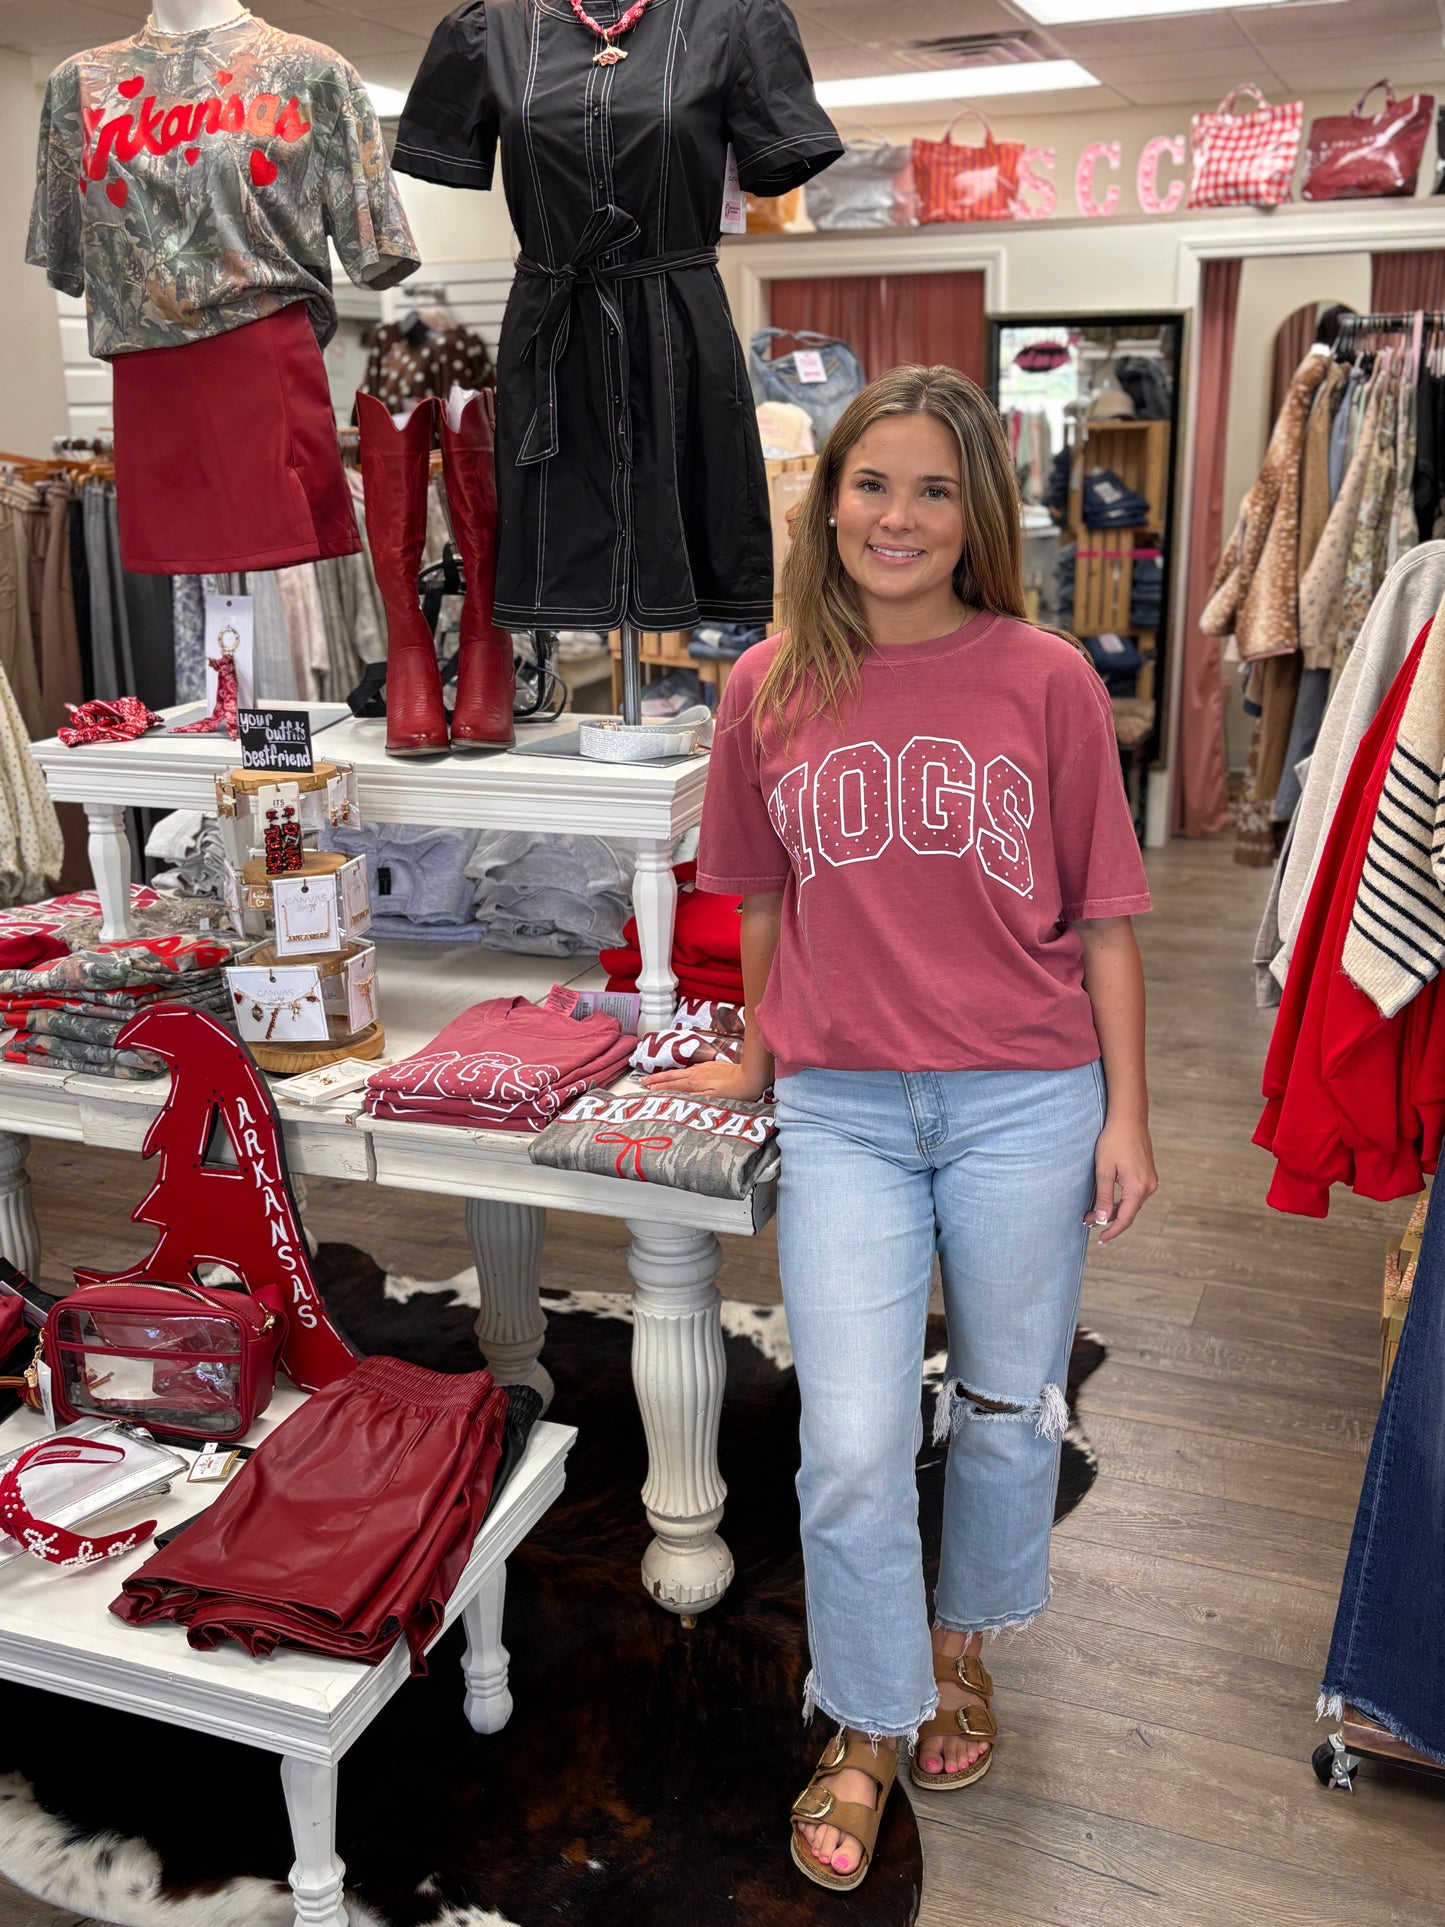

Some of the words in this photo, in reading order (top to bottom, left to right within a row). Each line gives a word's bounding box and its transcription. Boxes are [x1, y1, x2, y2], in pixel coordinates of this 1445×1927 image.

[82, 94, 311, 181] rkansas
[239, 712, 274, 734] your
[284, 894, 328, 906] CANVAS
[256, 988, 294, 997] CANVAS
[236, 1097, 318, 1329] ARKANSAS
